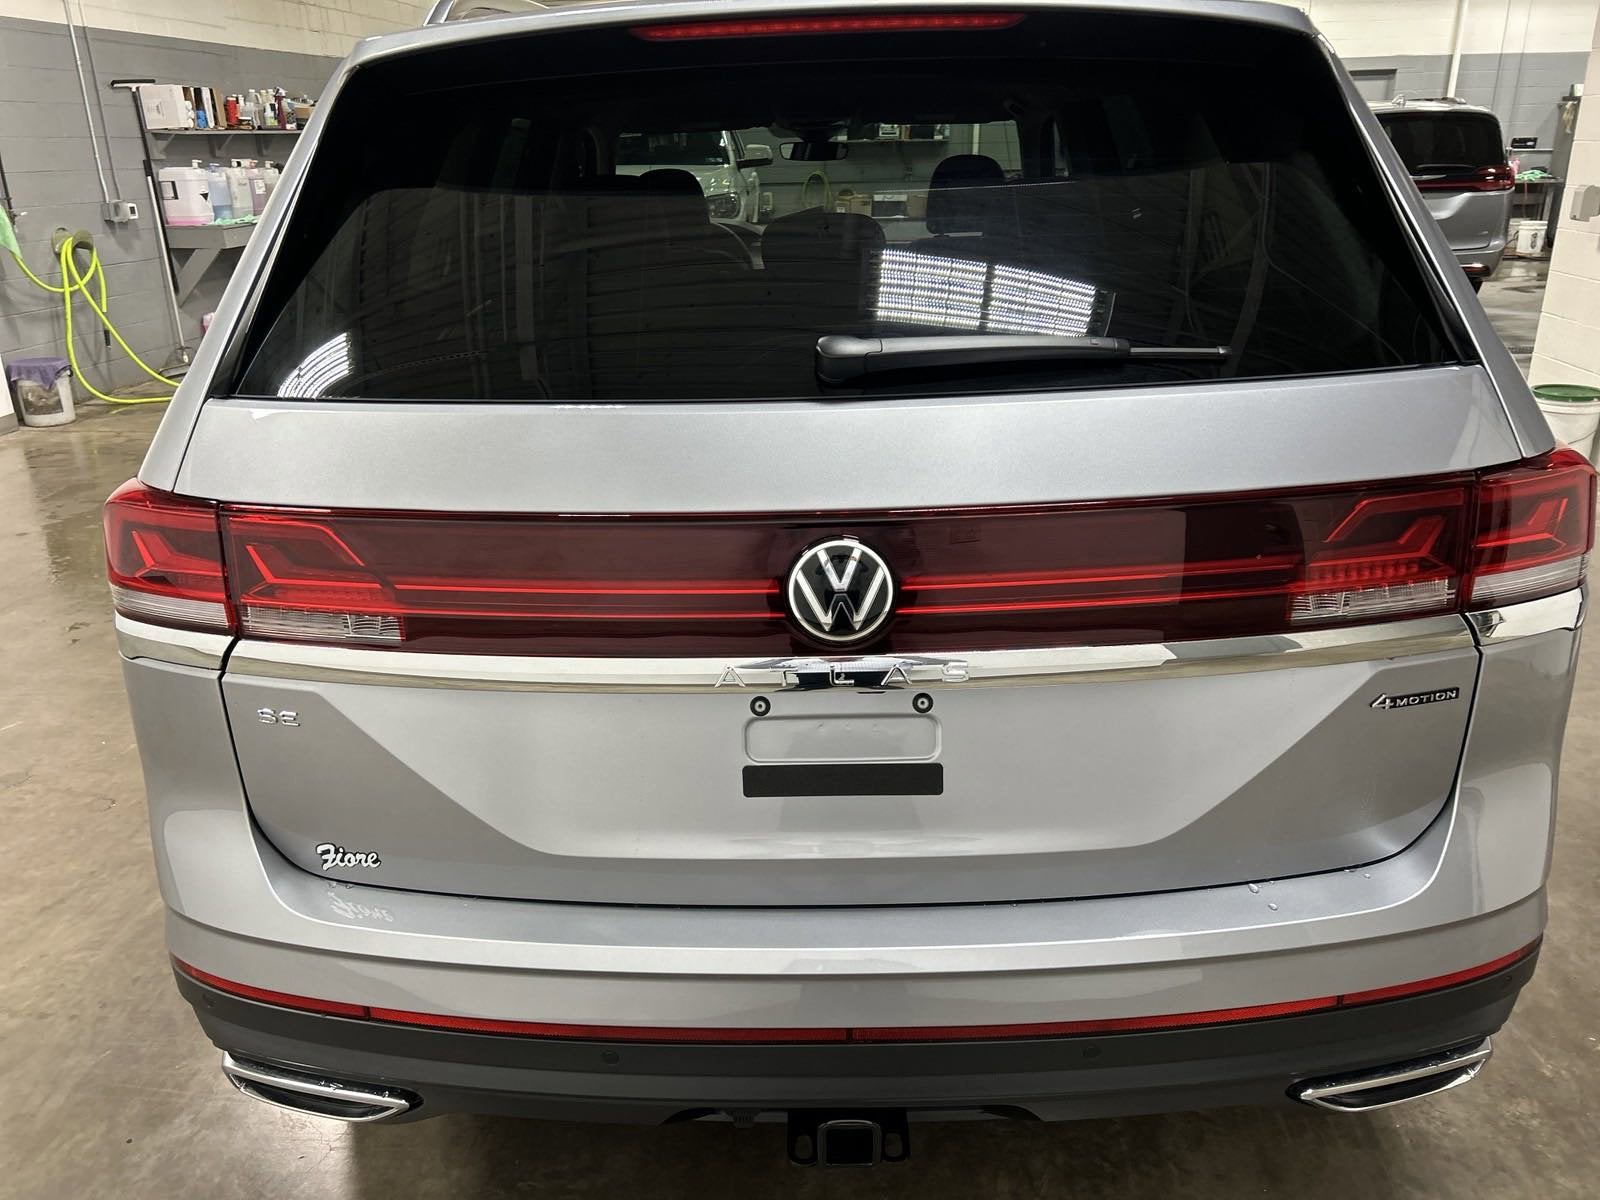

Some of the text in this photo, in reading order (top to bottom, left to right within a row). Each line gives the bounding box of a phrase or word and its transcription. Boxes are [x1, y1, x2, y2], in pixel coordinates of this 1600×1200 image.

[796, 547, 887, 633] VW
[715, 661, 969, 687] ATLAS
[1371, 689, 1457, 710] 4MOTION
[257, 707, 301, 726] SE
[315, 843, 381, 870] Fiore
